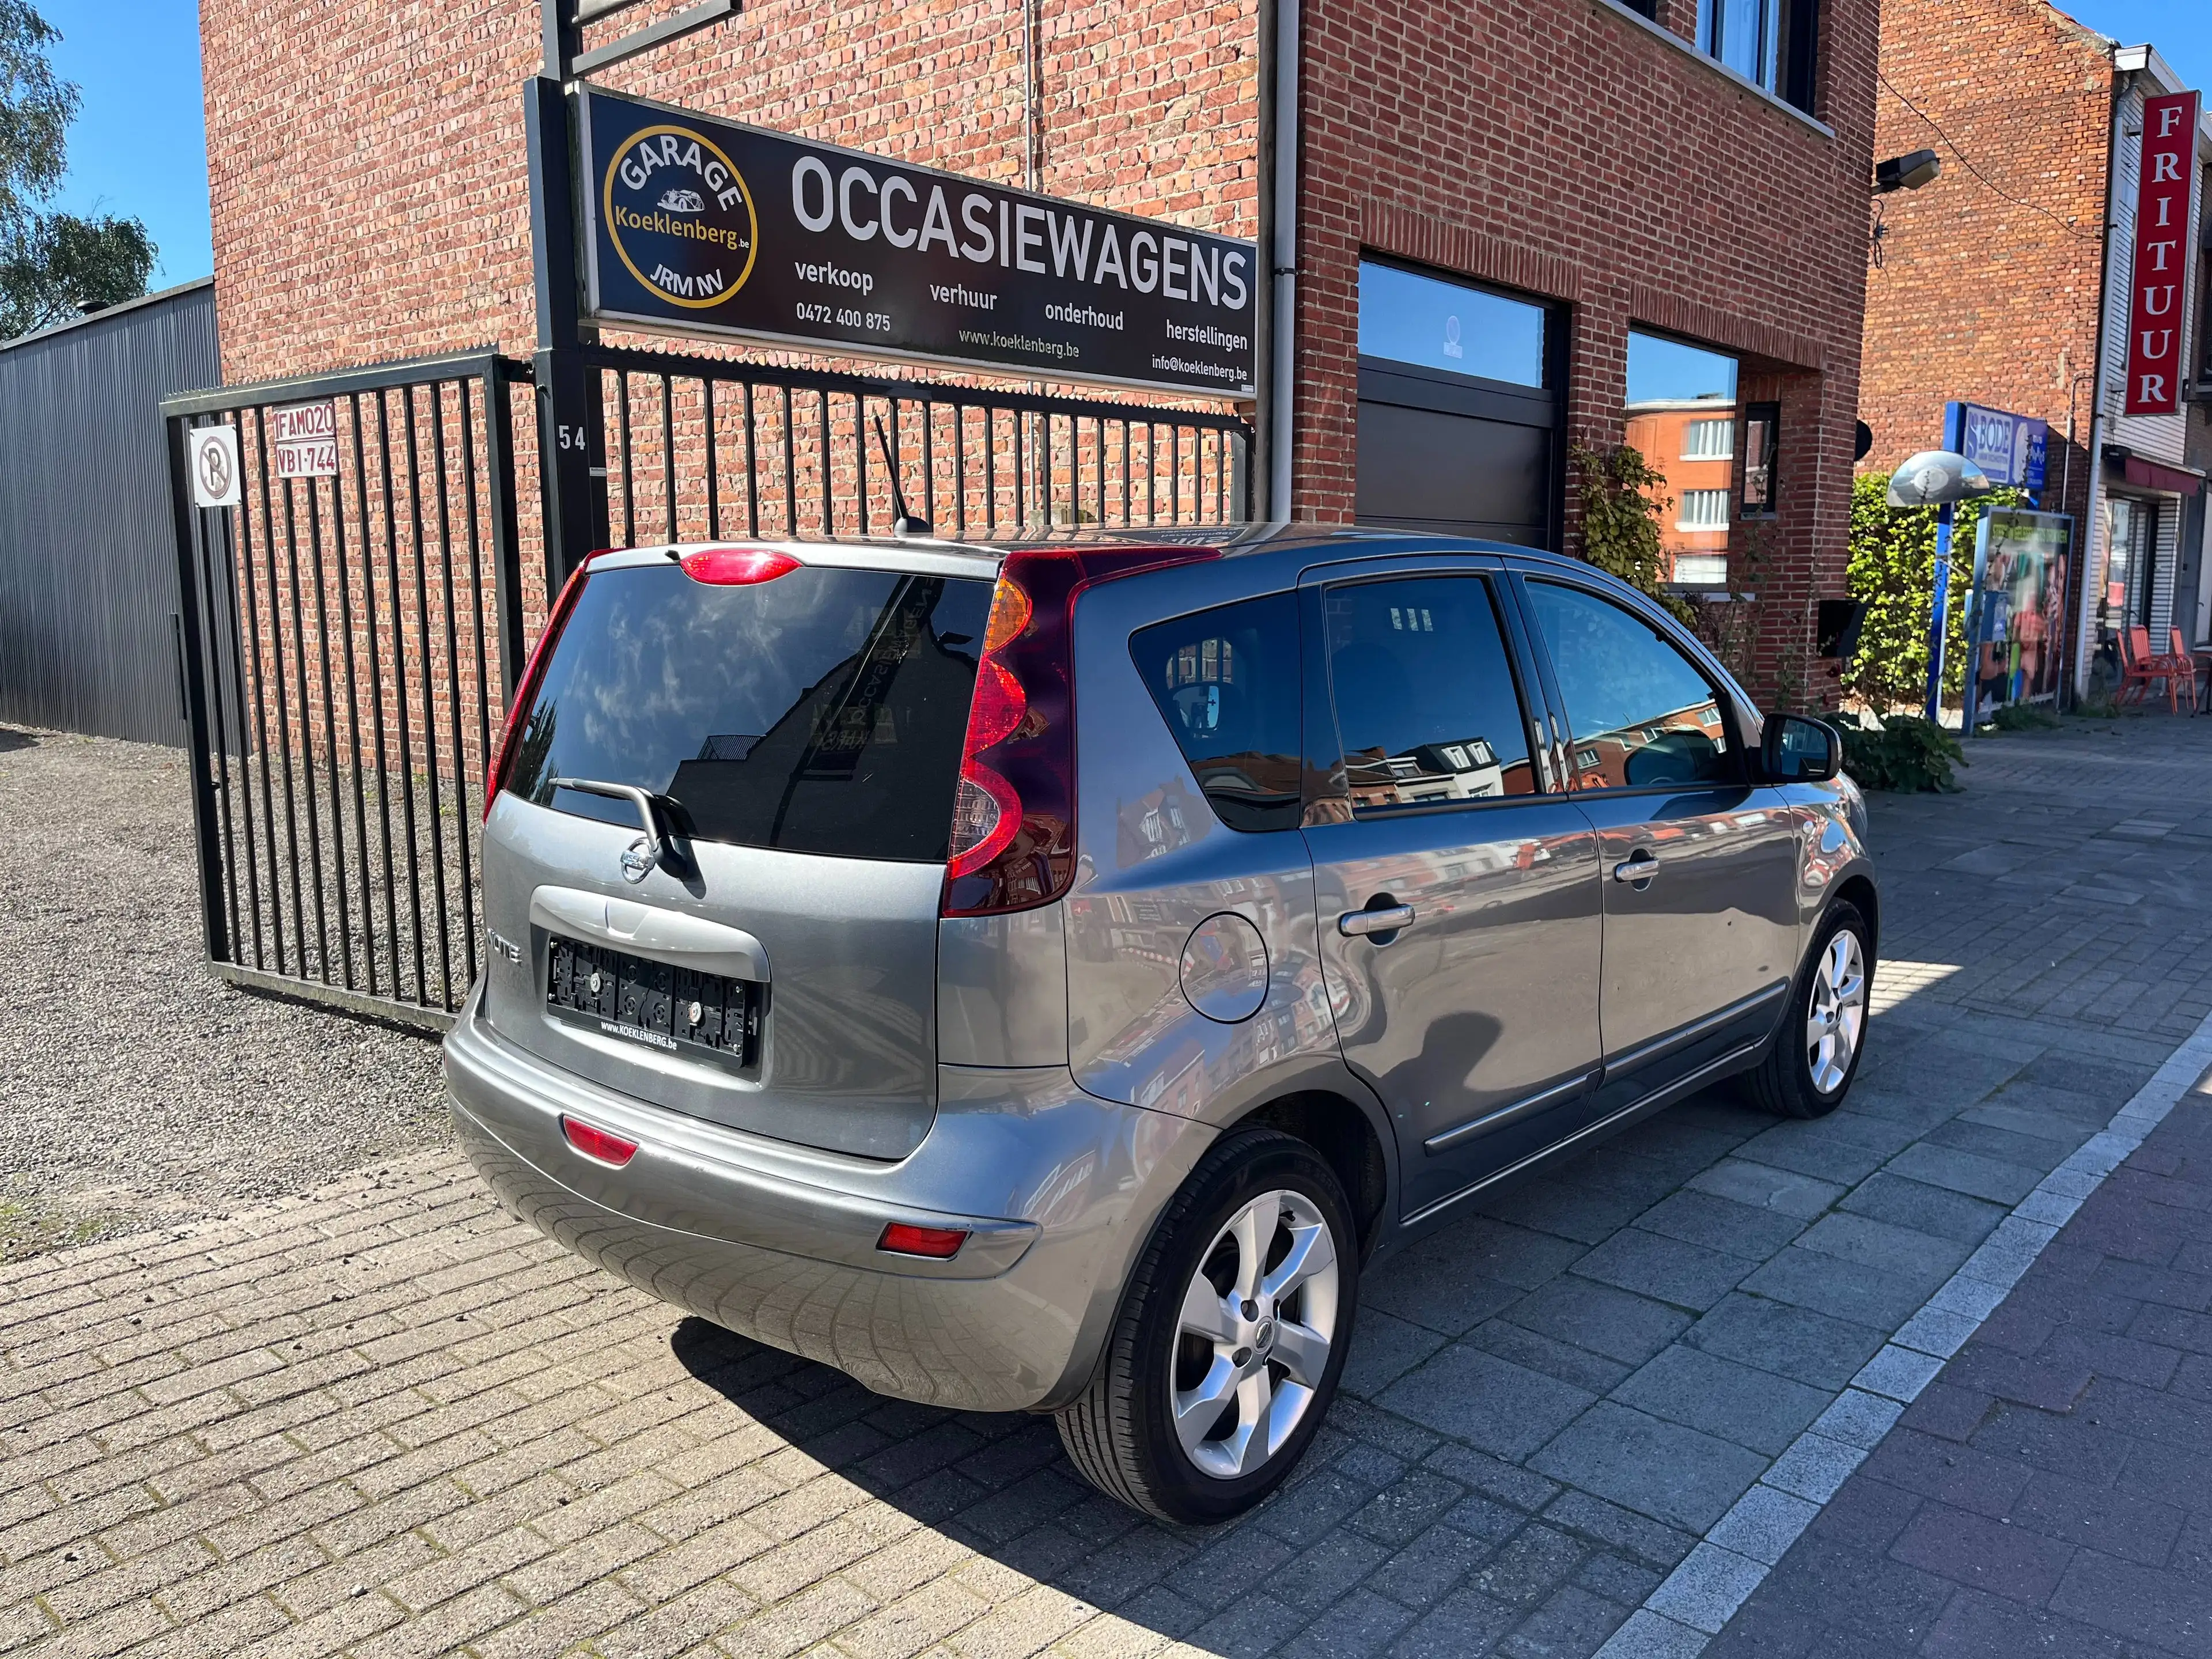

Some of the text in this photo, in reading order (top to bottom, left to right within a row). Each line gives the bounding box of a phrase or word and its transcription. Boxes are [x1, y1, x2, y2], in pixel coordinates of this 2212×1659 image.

[620, 136, 743, 211] GARAGE
[792, 156, 1248, 310] OCCASIEWAGENS
[2138, 106, 2183, 403] FRITUUR
[650, 263, 724, 297] JRM NV
[794, 261, 873, 296] verkoop
[930, 283, 998, 310] verhuur
[796, 302, 891, 331] 0472 400 875
[1045, 302, 1124, 331] onderhoud
[959, 329, 1080, 359] www.koeklenberg.be
[1166, 319, 1247, 352] herstellingen
[1152, 354, 1247, 382] info@koeklenberg.be
[1978, 415, 2010, 453] BODE
[620, 851, 648, 865] NISS
[486, 927, 522, 963] NOTE
[601, 1021, 677, 1050] www.KOEKLENBERG.be
